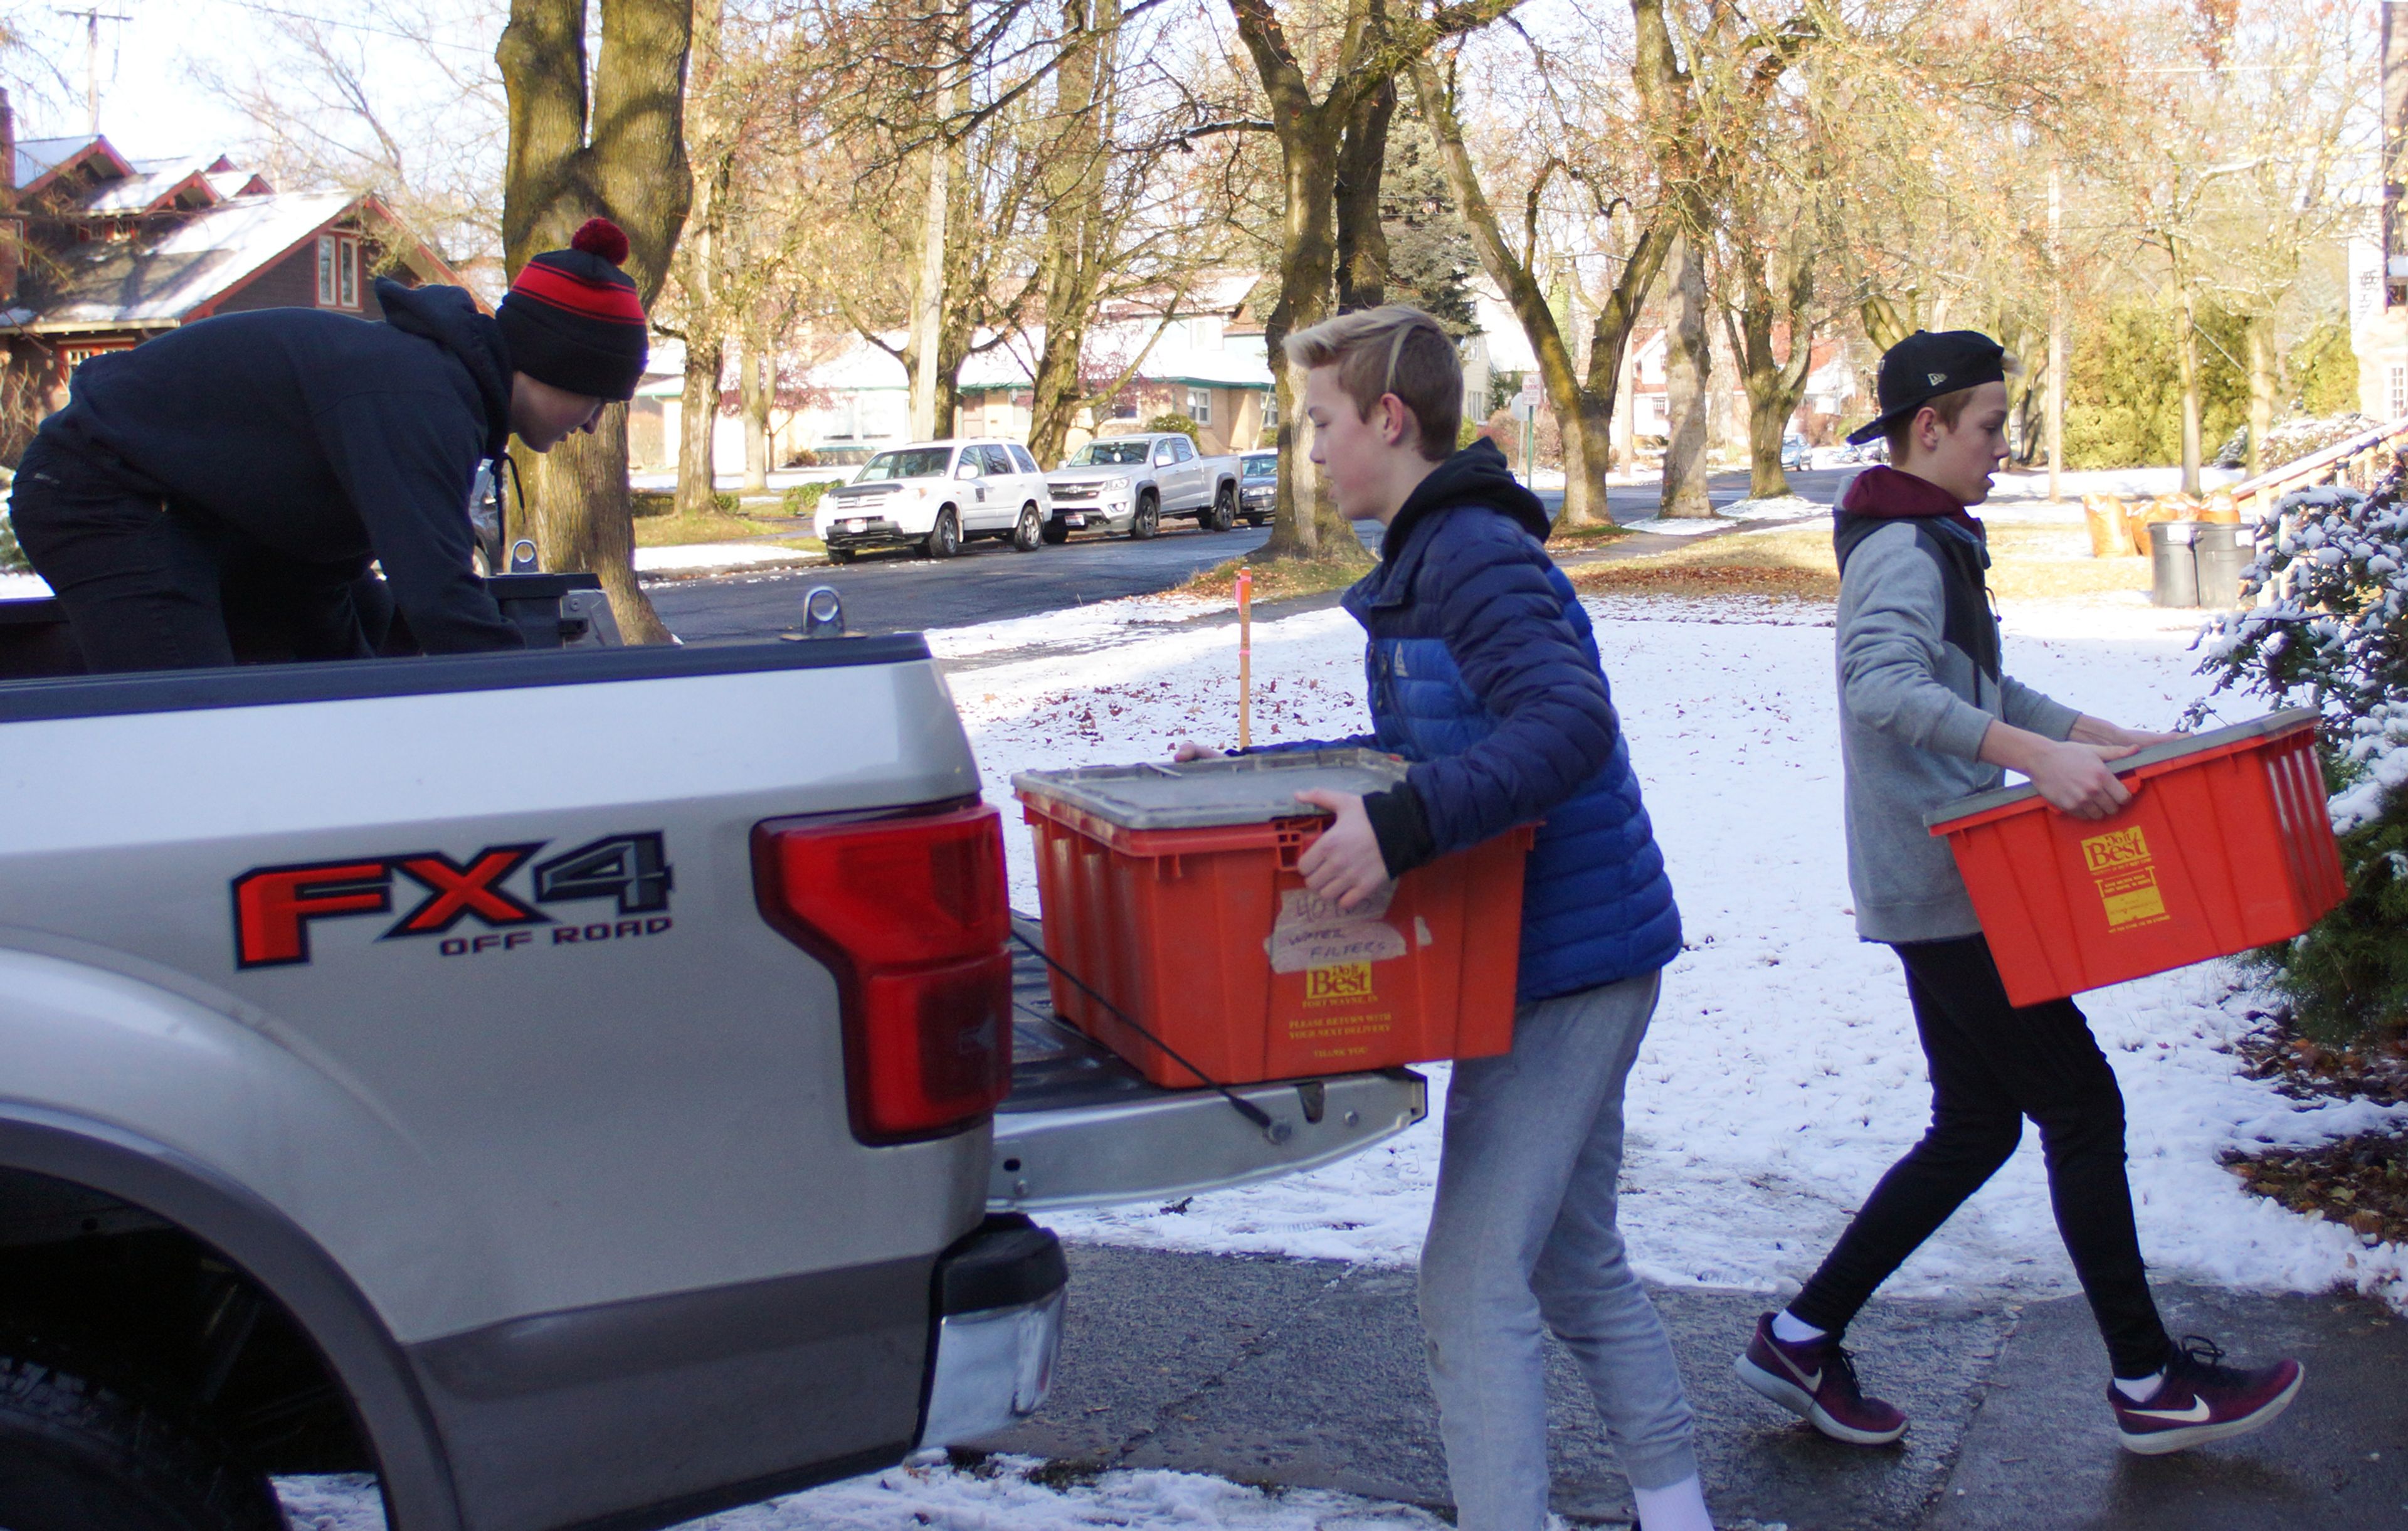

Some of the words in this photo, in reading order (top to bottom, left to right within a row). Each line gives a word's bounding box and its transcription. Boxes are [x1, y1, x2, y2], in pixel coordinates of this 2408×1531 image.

[2086, 832, 2145, 866] Best
[2104, 834, 2123, 846] Do
[232, 830, 673, 972] FX4
[440, 931, 533, 956] OFF
[552, 916, 673, 946] ROAD
[1311, 969, 1368, 995] Best
[1289, 1019, 1323, 1029] PLEASE
[1326, 1015, 1364, 1026] RETURN
[1366, 1012, 1392, 1022] WITH
